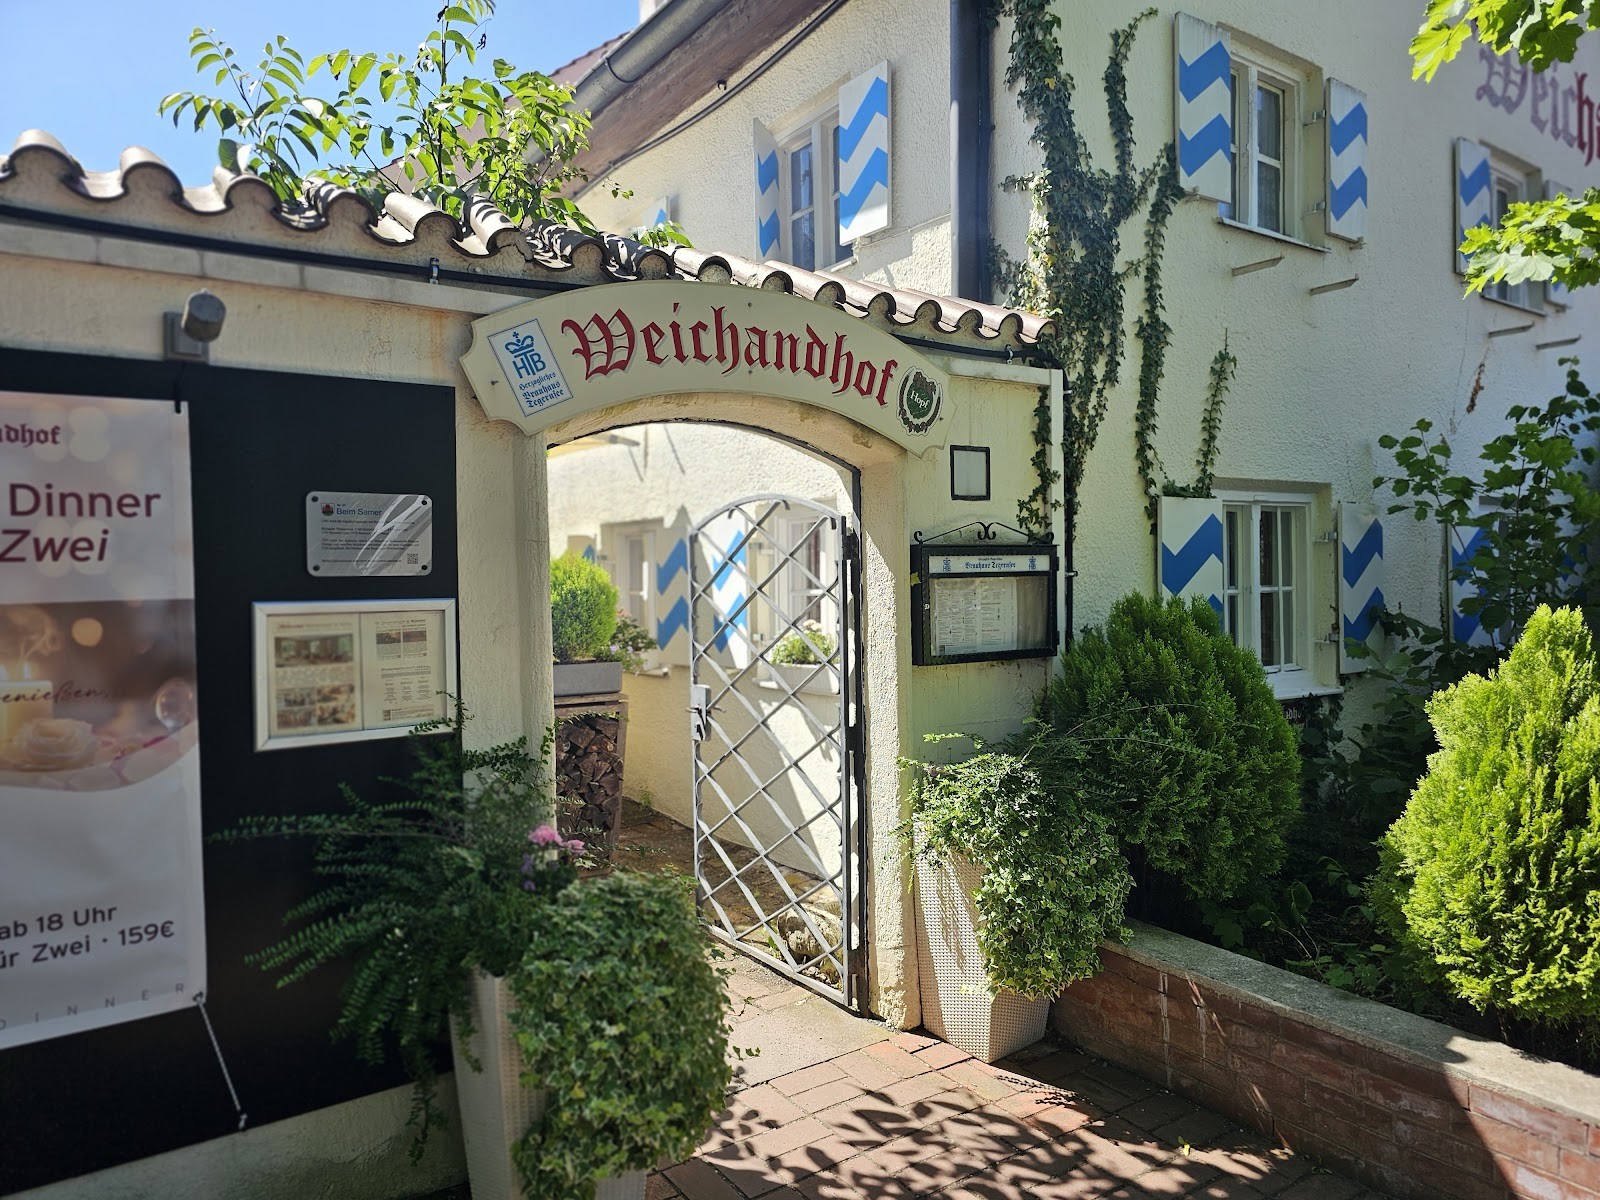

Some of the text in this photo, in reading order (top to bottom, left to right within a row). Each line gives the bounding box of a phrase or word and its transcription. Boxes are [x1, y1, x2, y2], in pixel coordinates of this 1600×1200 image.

[561, 302, 898, 406] Weichandhof
[519, 372, 556, 391] Herzogliches
[522, 381, 560, 400] Brauhaus
[910, 390, 931, 408] Hopf
[0, 424, 61, 448] dhof
[9, 483, 161, 518] Dinner
[336, 508, 356, 516] Beim
[0, 529, 109, 562] Zwei
[0, 907, 118, 940] ab 18 Uhr
[32, 935, 91, 963] Zwei
[118, 921, 175, 946] 159€
